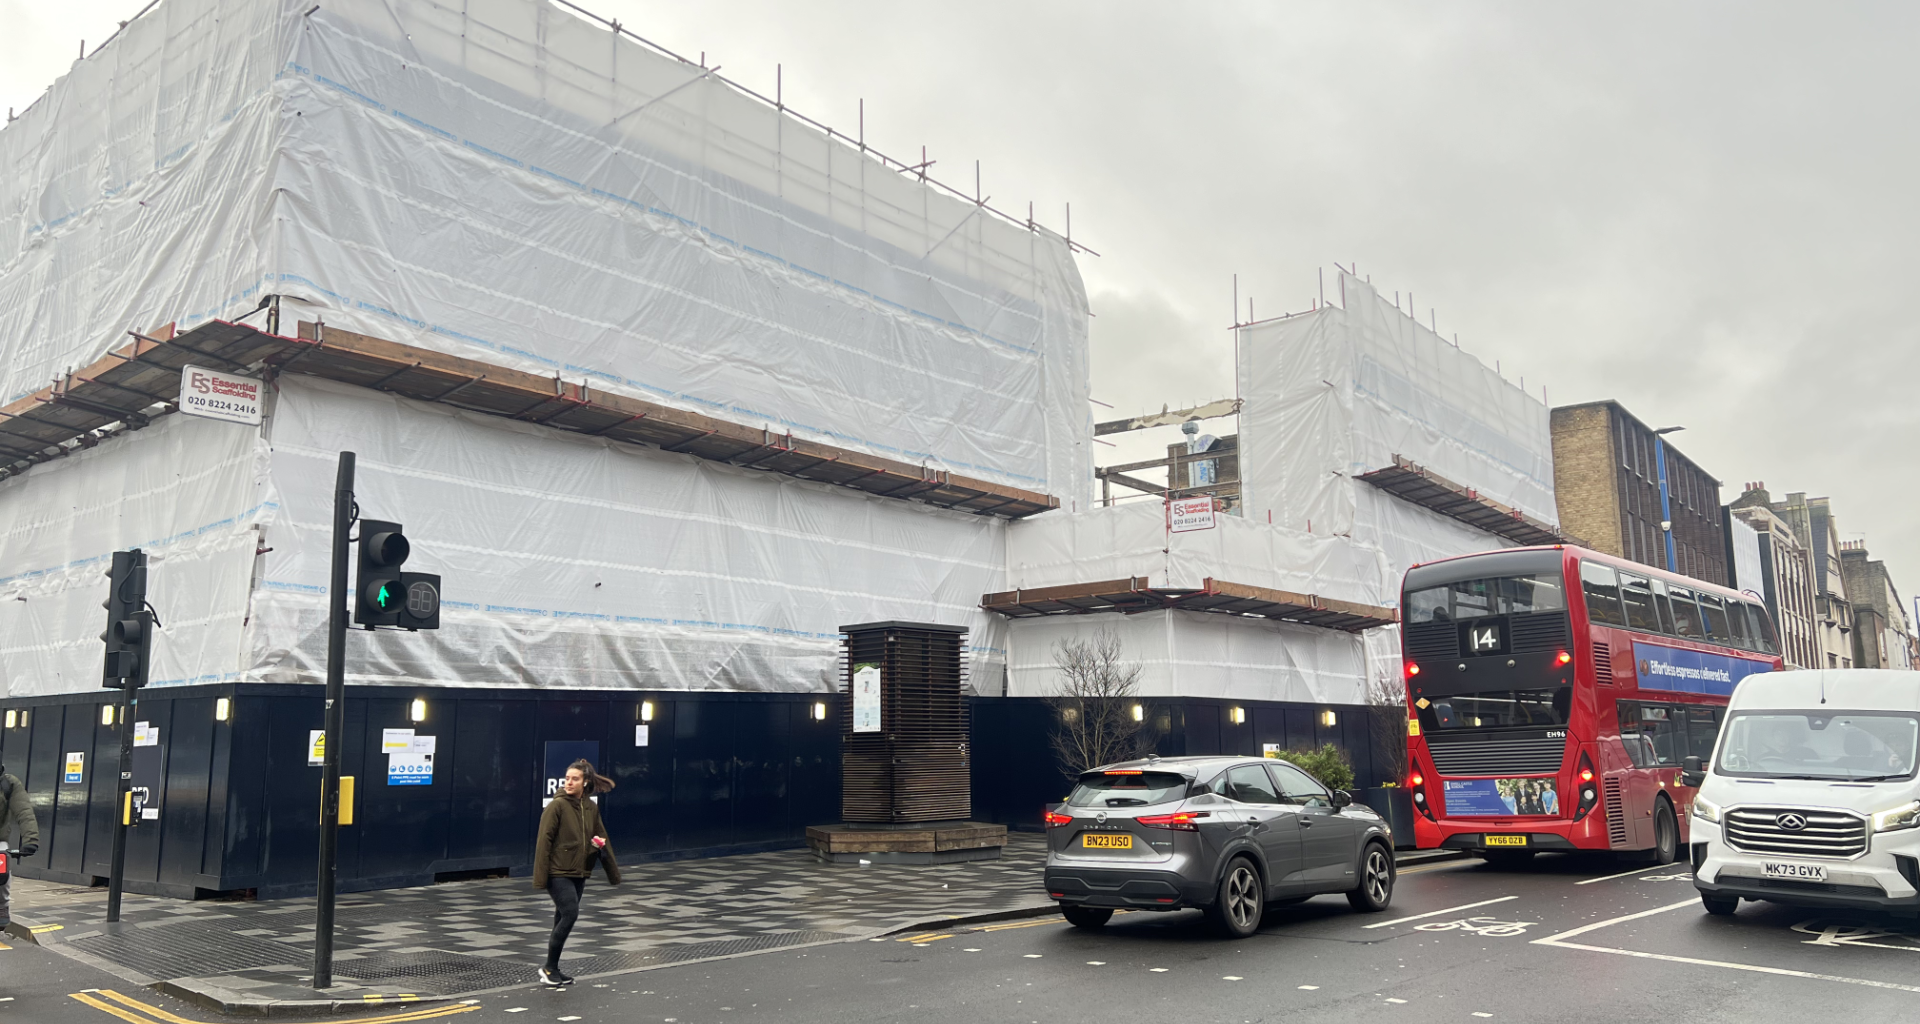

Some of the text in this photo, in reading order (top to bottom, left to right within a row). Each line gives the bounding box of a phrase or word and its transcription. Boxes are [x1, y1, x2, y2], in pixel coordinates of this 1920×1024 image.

[191, 372, 210, 394] ES
[211, 377, 257, 393] Essential
[211, 386, 256, 401] Scaffolding
[188, 396, 206, 406] 020
[208, 399, 231, 410] 8224
[234, 403, 256, 414] 2416
[1174, 504, 1184, 516] ES
[1184, 501, 1209, 509] Essential
[1473, 628, 1496, 650] 14
[1650, 660, 1731, 683] Effortless espressos delivered fast.
[1086, 836, 1129, 847] BN23 USO
[1488, 836, 1523, 845] YY66 OZB
[1765, 863, 1822, 877] MK73 GVX
